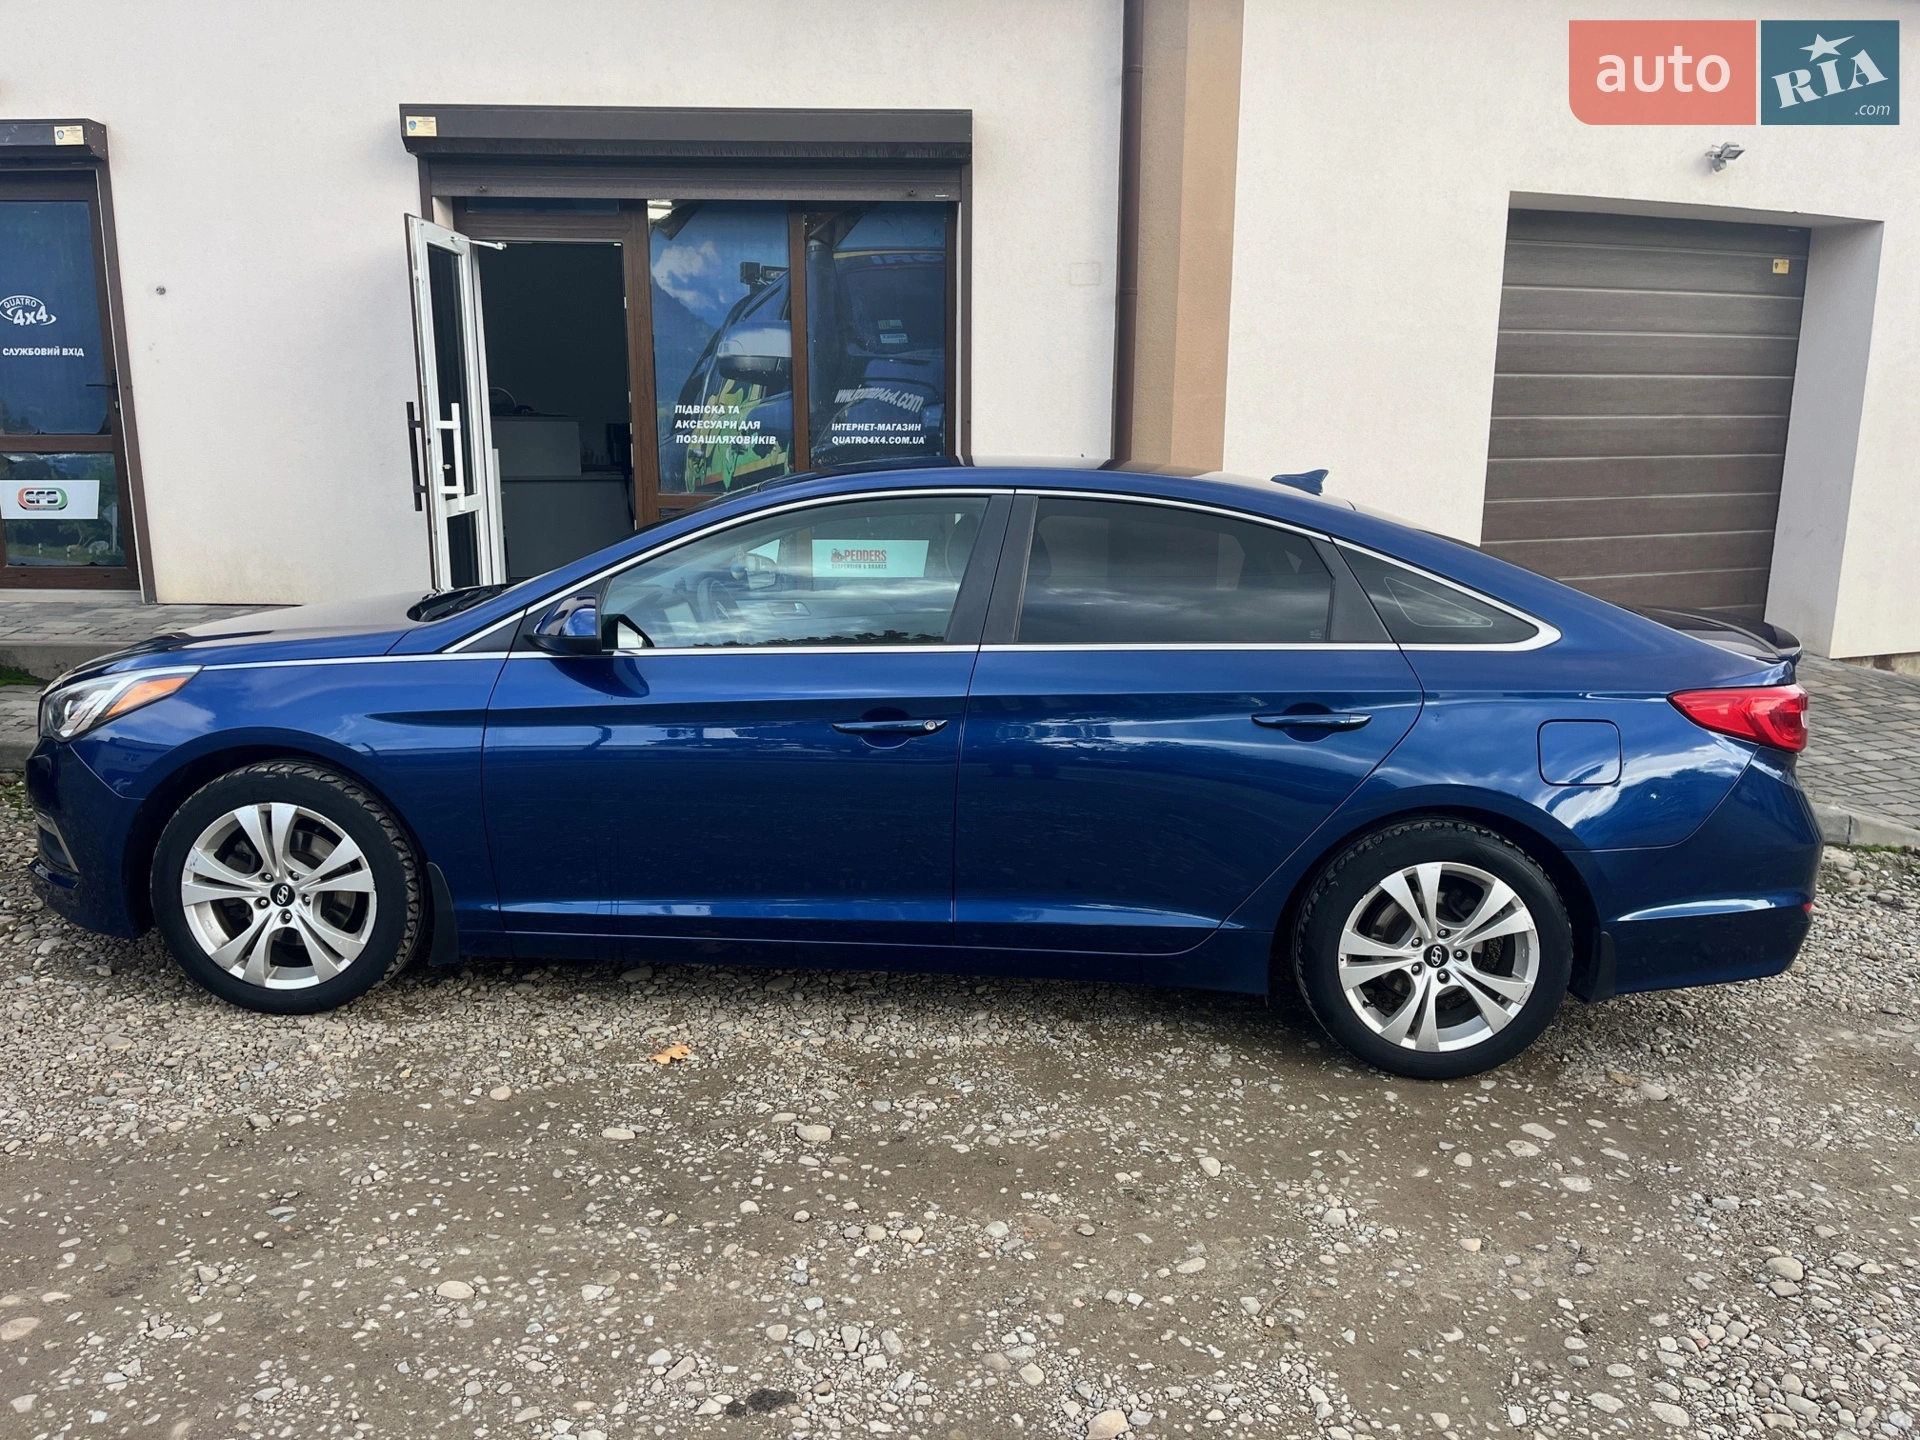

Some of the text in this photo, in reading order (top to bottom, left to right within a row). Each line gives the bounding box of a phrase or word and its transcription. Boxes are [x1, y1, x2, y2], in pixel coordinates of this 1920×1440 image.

[3, 297, 37, 309] QUATRO
[13, 305, 48, 326] 4x4
[2, 345, 85, 357] СЛУЖБОВИЙ ВХІД
[674, 405, 740, 415] ПІДВІСКА ТА
[675, 420, 760, 430] АКСЕСУАРИ ДЛЯ
[831, 423, 921, 431] ІНТЕРНЕТ-МАГАЗИН
[676, 434, 776, 445] ПОЗАШЛЯХОВИКІВ
[831, 436, 925, 446] QUATRO4X4.COM.UA
[844, 549, 887, 562] PEDDERS
